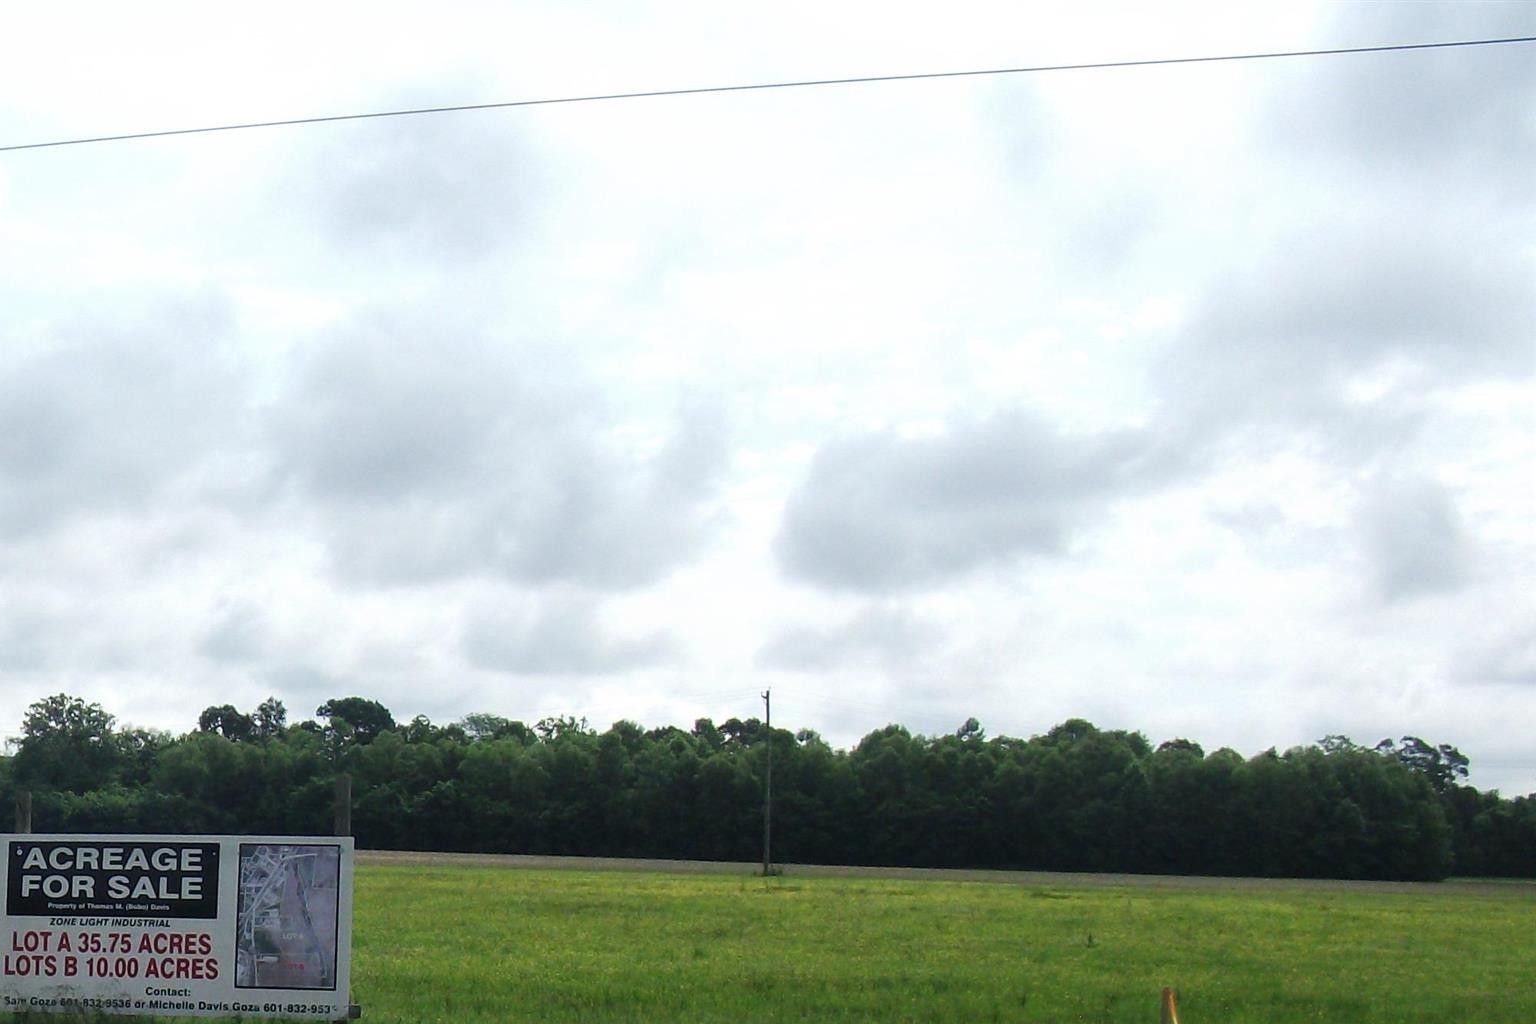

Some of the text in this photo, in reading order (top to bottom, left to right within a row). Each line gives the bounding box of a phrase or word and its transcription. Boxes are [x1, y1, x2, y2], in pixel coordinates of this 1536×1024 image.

[22, 846, 204, 872] ACREAGE
[20, 875, 204, 900] FOR SALE
[47, 902, 77, 910] Property
[49, 917, 171, 928] ZONE LIGHT INDUSTRIAL
[12, 931, 212, 955] LOT A 35.75 ACRES
[4, 955, 219, 980] LOTS B 10.00 ACRES
[145, 986, 192, 997] Contact:
[134, 1000, 146, 1009] or
[148, 1000, 195, 1011] Michelle
[198, 1001, 229, 1012] Davis
[232, 1002, 260, 1012] Goza
